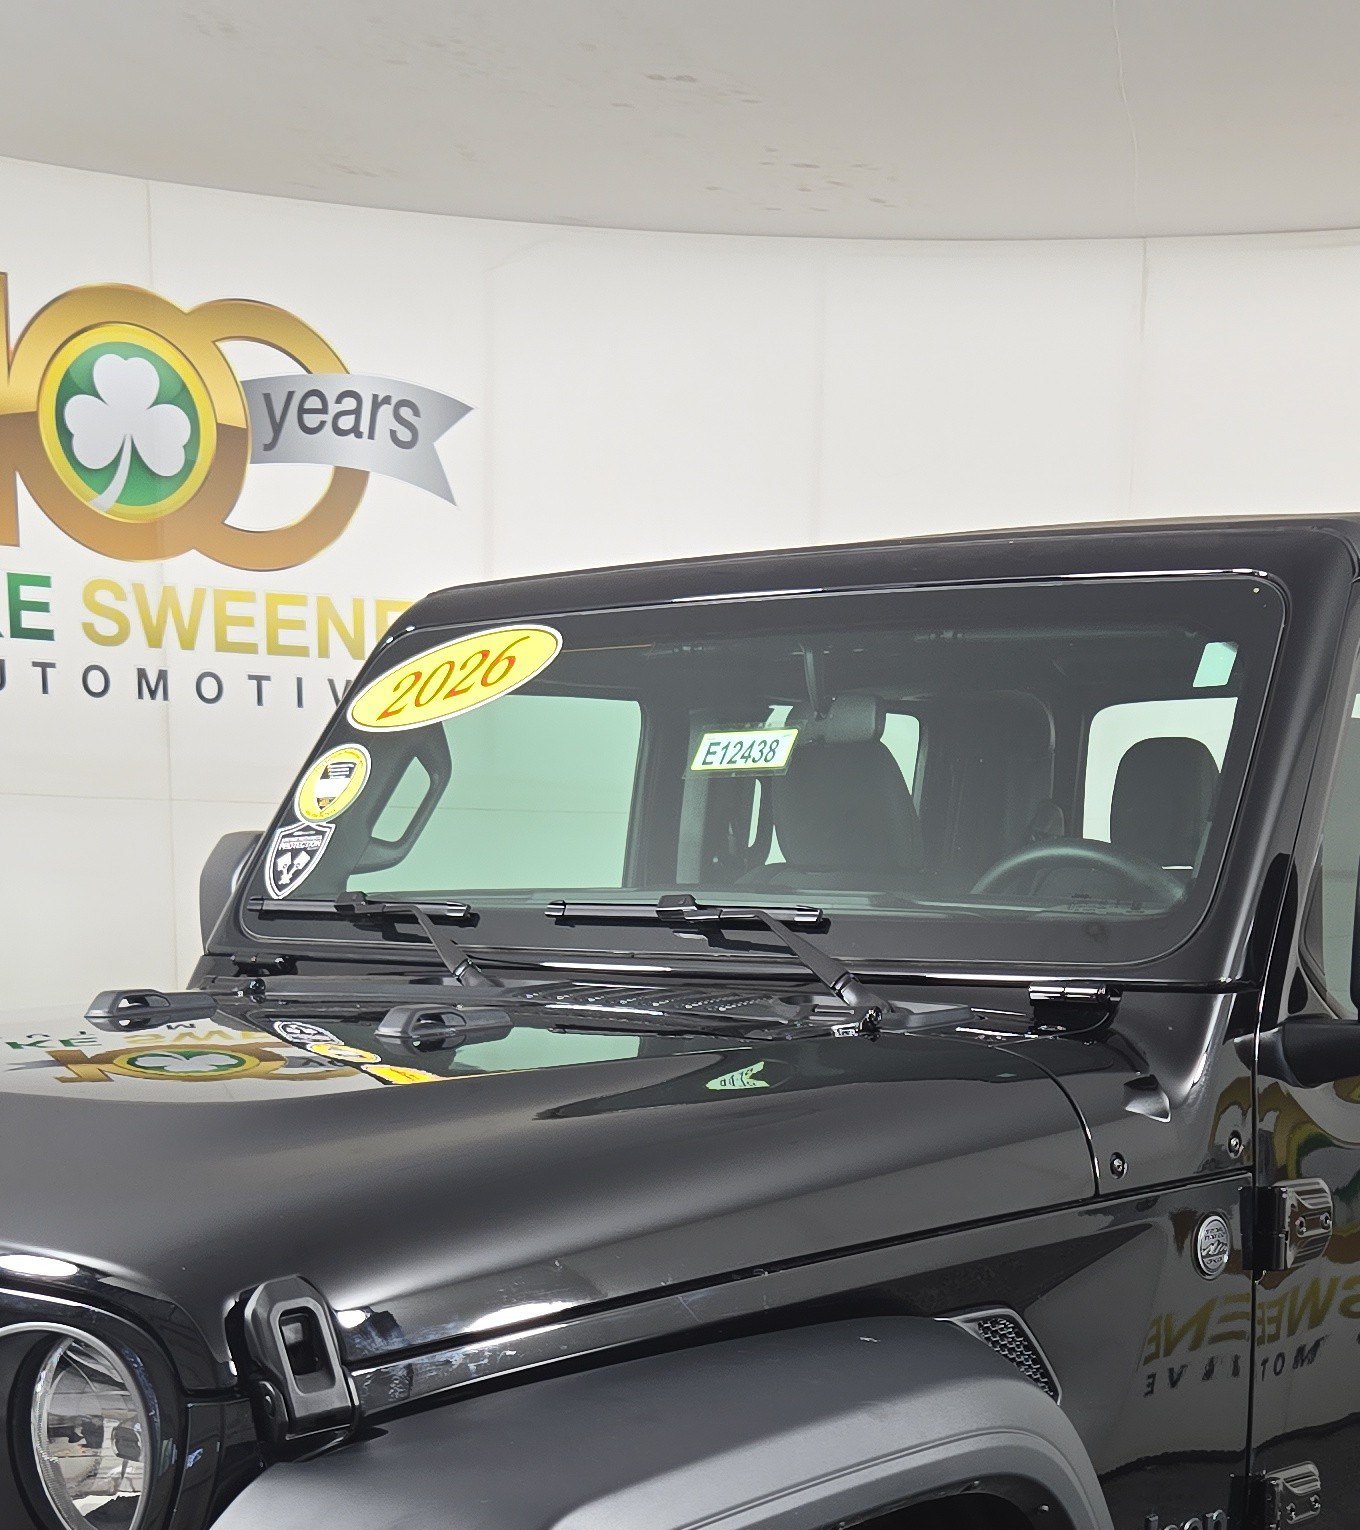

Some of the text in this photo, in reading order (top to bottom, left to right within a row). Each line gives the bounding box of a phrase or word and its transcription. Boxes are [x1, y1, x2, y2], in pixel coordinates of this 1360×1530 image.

[260, 388, 421, 452] years
[375, 635, 531, 722] 2026
[701, 738, 781, 767] E12438
